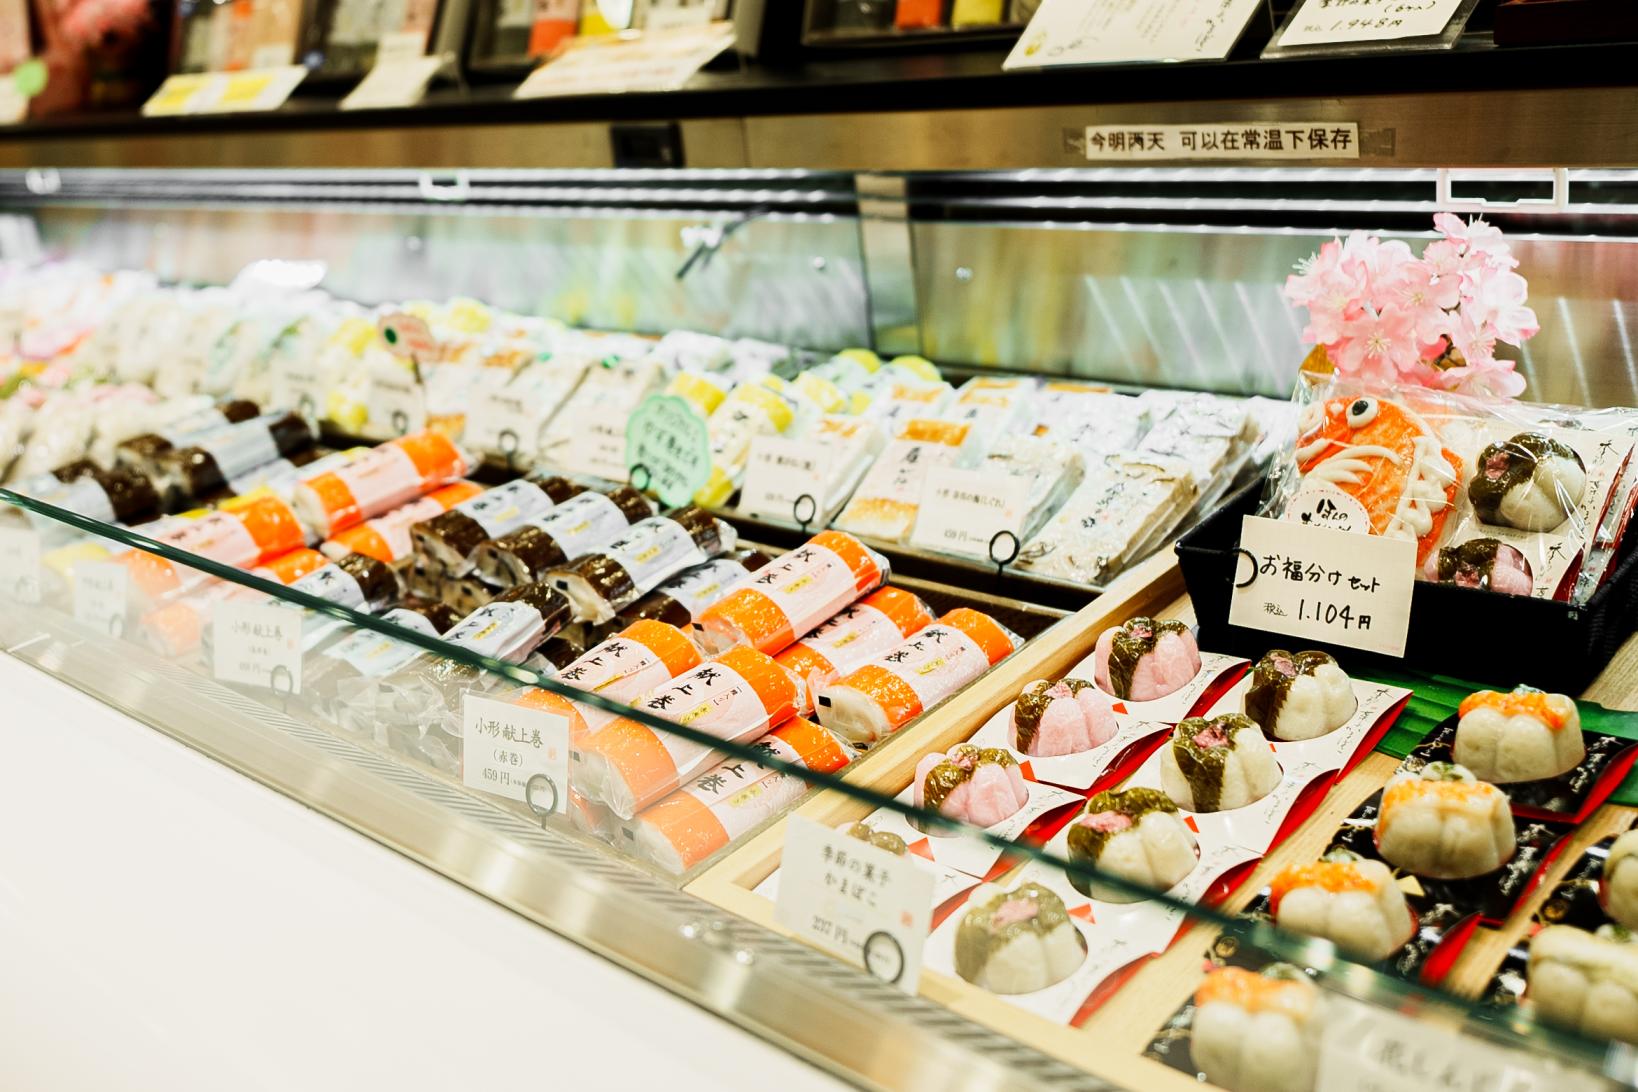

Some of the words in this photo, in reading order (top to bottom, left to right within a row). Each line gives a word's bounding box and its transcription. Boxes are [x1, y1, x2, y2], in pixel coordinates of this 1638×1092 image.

[1090, 131, 1165, 153] 今明两天
[1180, 128, 1352, 151] 可以在常温下保存
[1260, 555, 1380, 593] お福分けセット
[1263, 602, 1288, 617] 税込
[475, 716, 544, 749] 小形献上巻
[493, 749, 523, 767] (赤巻)
[822, 844, 889, 887] 季節の菓子
[823, 872, 878, 907] かまぼこ
